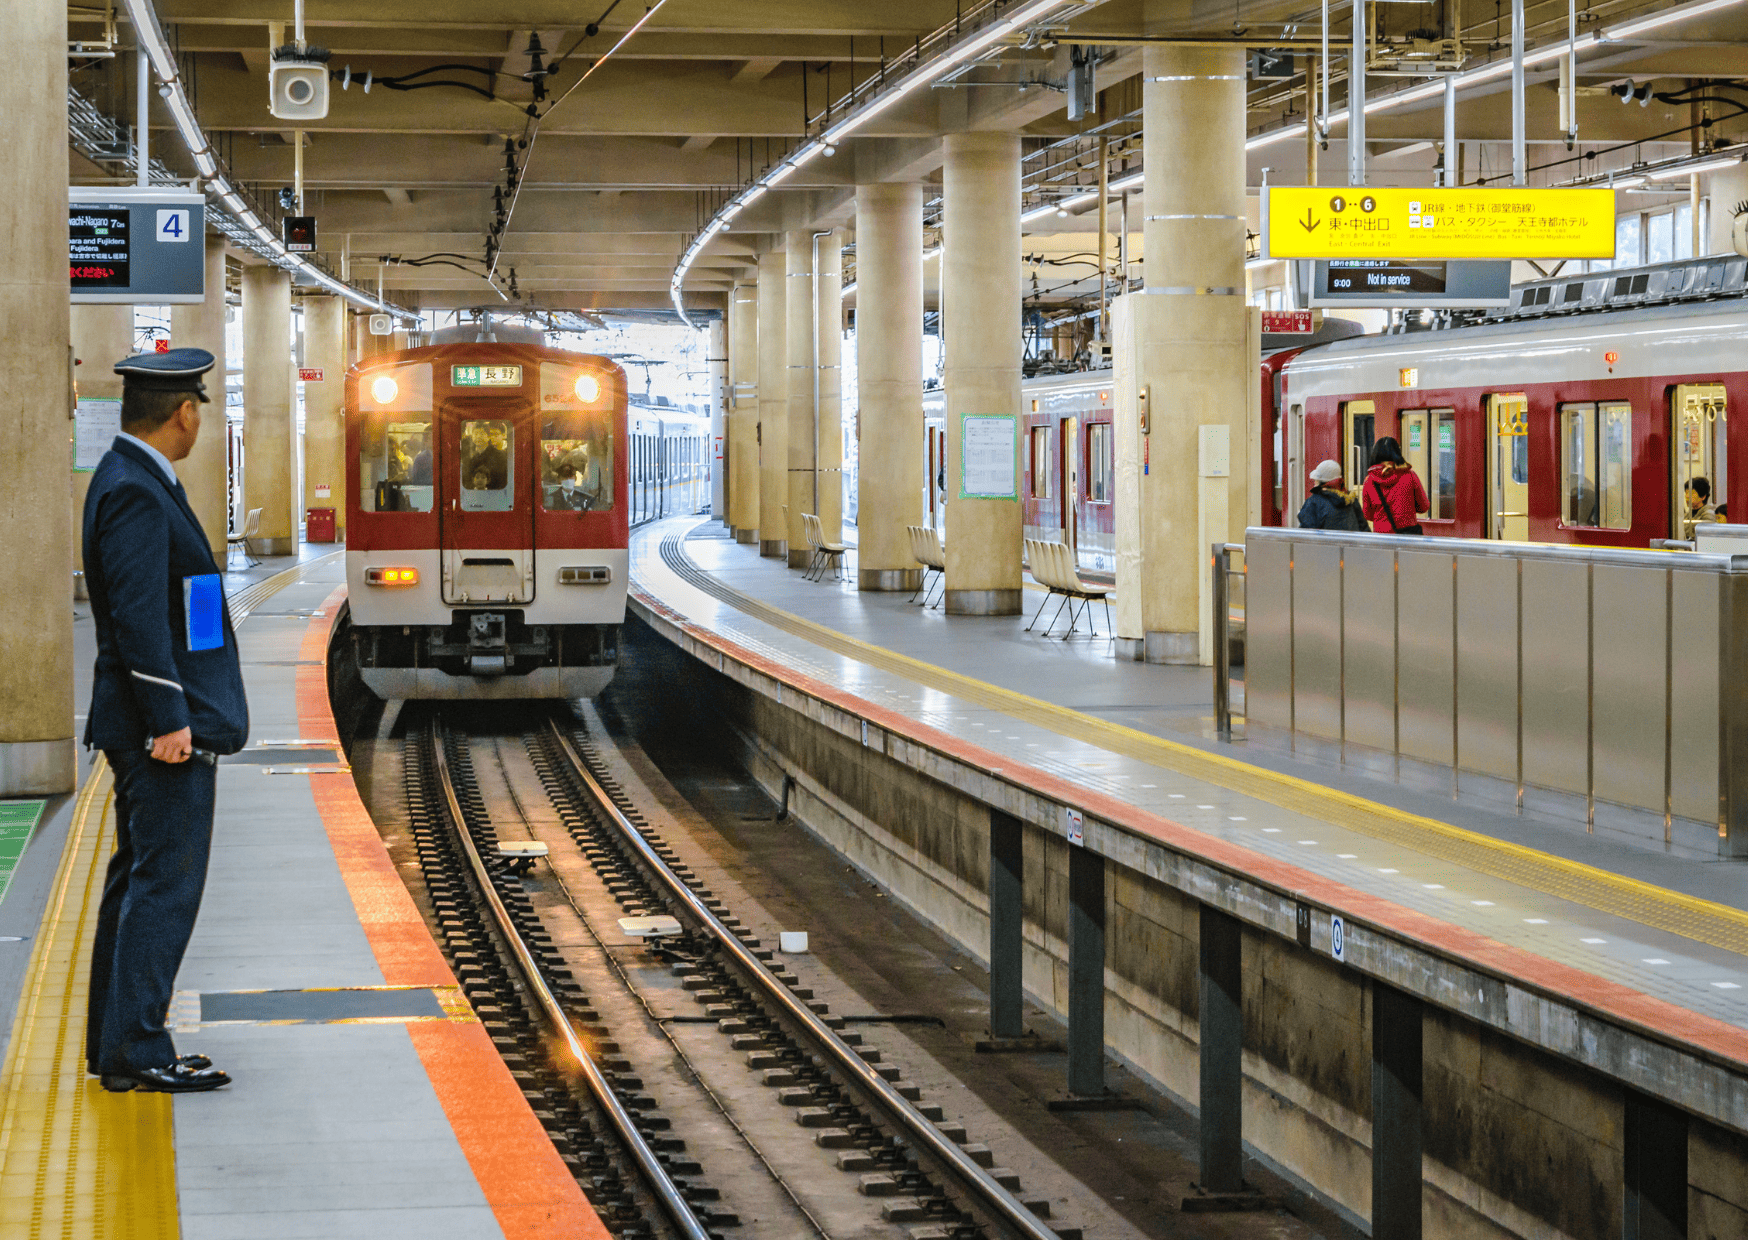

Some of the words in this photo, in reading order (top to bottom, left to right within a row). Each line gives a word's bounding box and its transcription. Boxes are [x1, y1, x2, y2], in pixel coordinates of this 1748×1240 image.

[110, 219, 118, 227] 7
[163, 214, 182, 237] 4
[1435, 217, 1507, 227] バス・タクシー
[1518, 216, 1588, 227] 天王寺都ホテル
[1334, 278, 1352, 288] 9:00
[1367, 272, 1380, 285] Not
[1380, 273, 1387, 285] in
[1387, 273, 1411, 285] service
[485, 367, 515, 380] 長野
